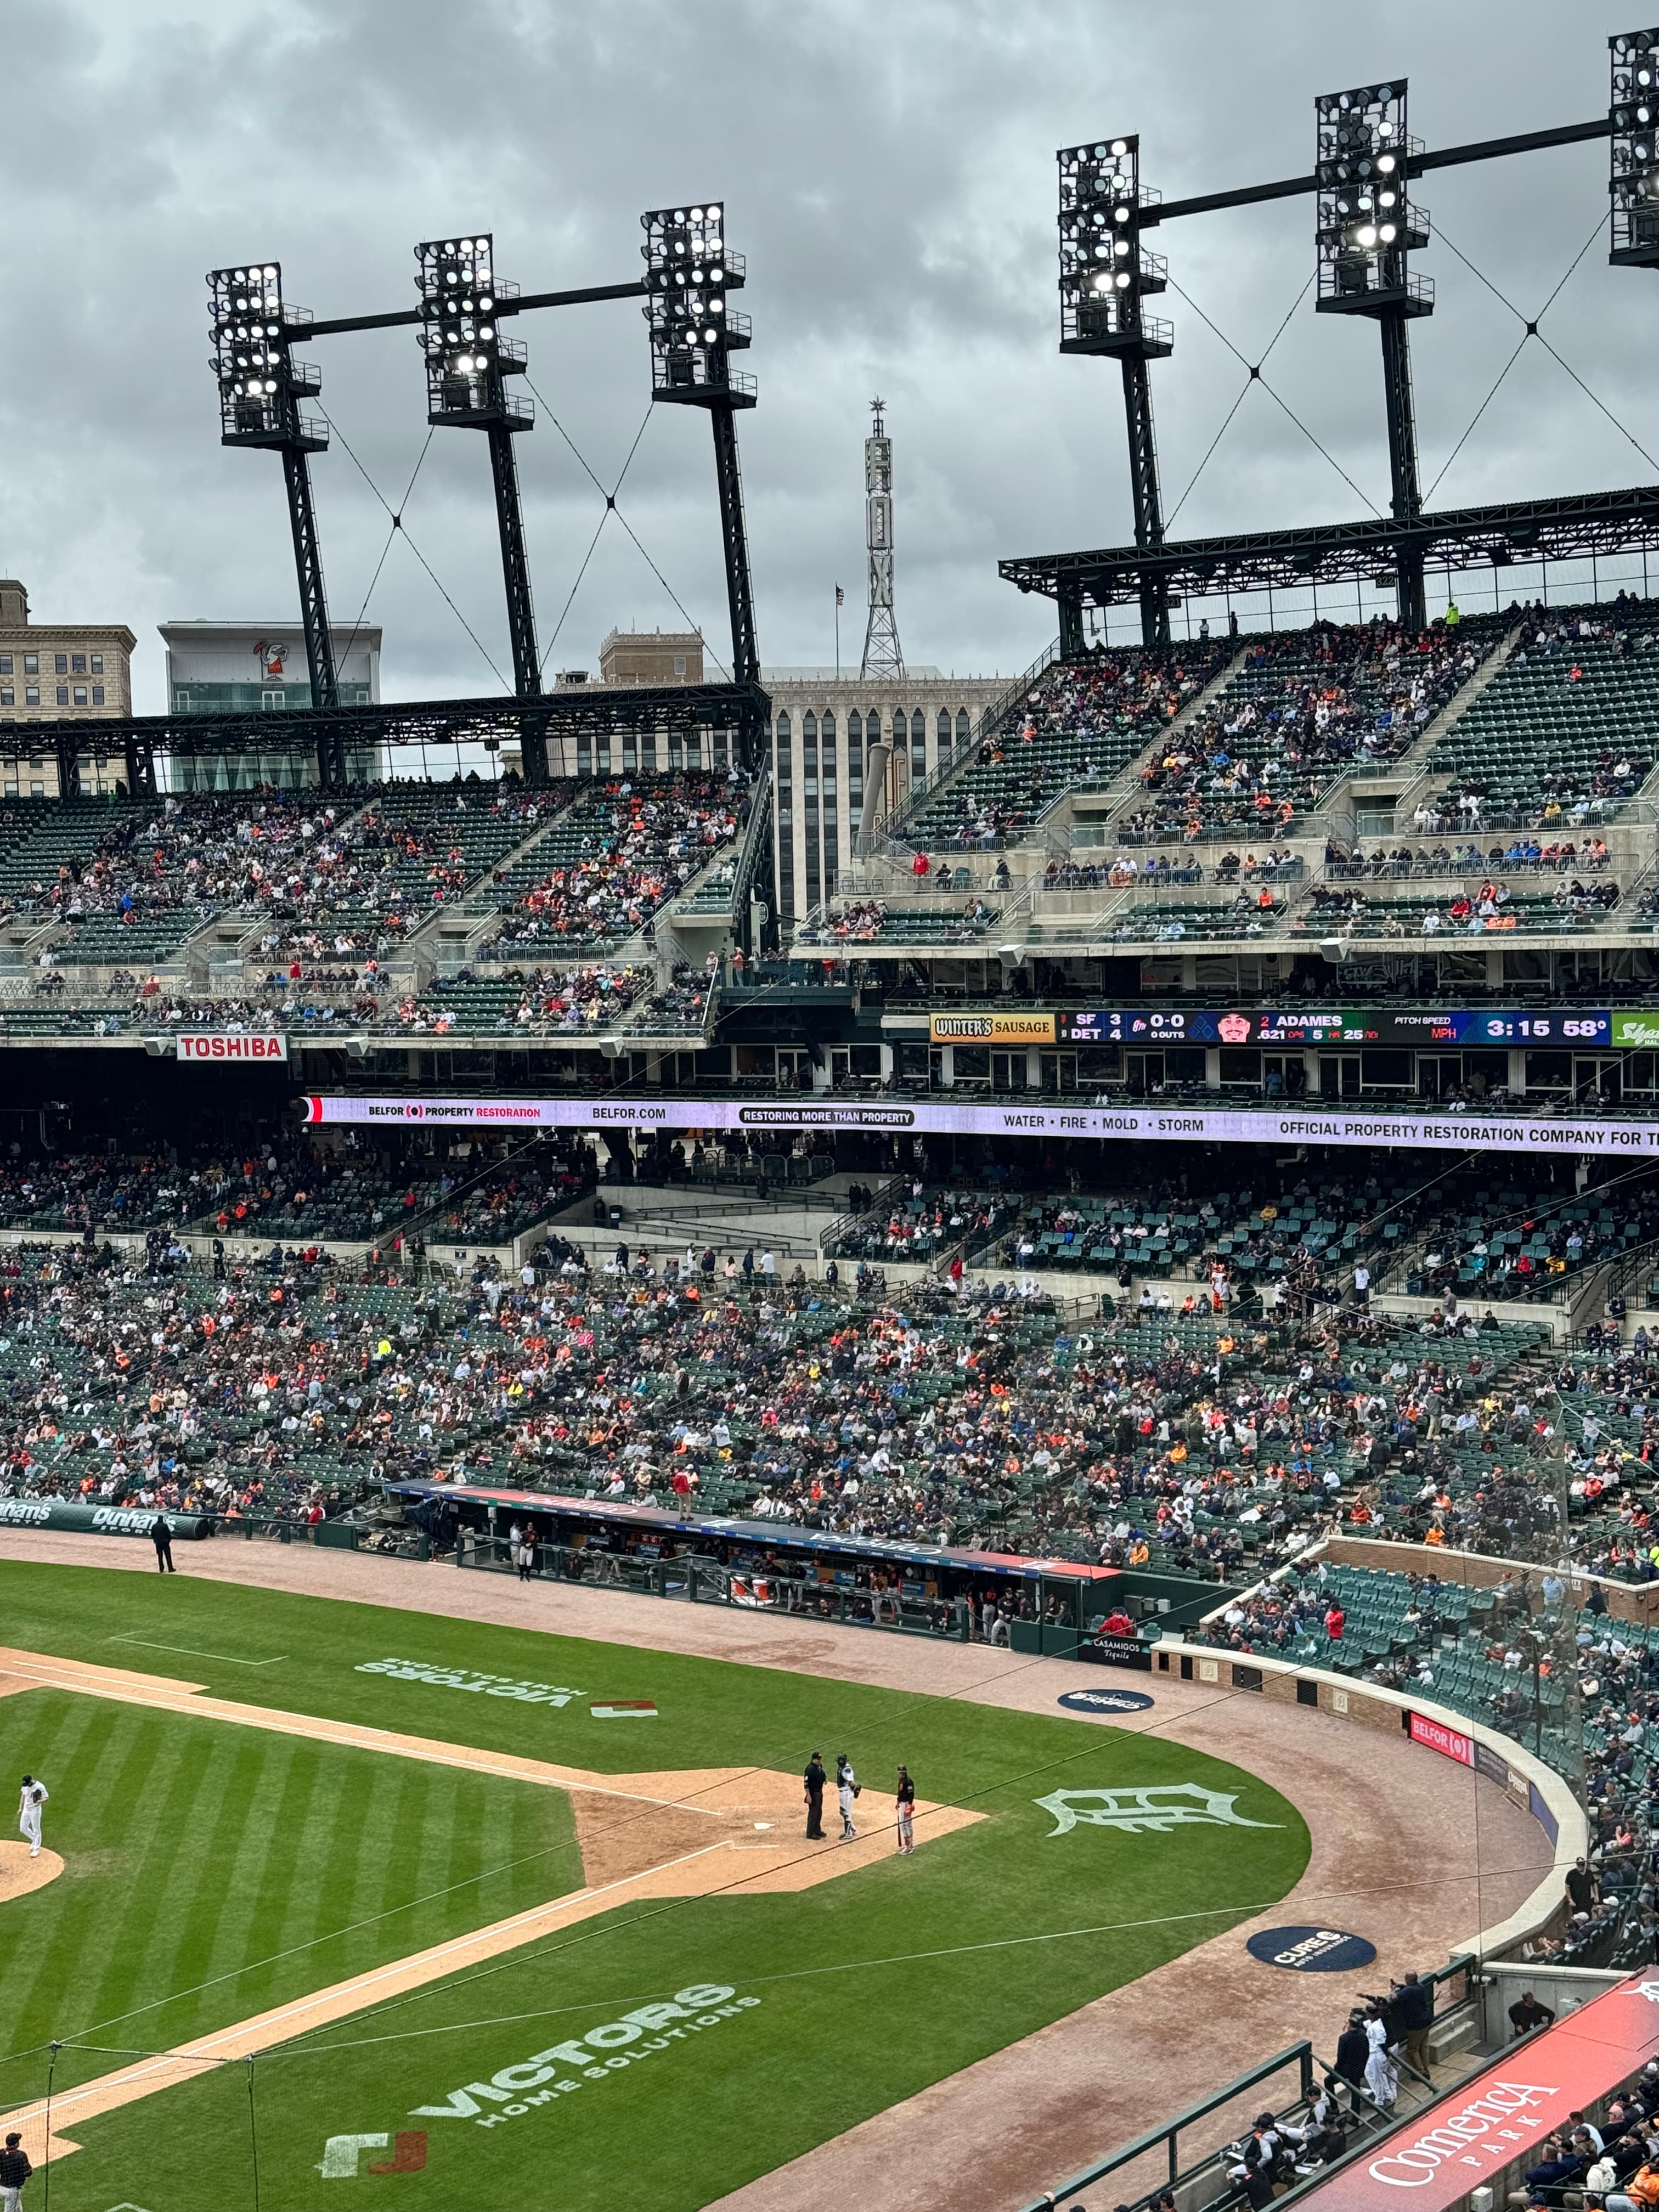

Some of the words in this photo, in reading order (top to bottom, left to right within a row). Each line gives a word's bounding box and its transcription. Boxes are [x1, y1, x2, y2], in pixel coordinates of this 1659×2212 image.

[1076, 1014, 1096, 1025] SF
[1109, 1014, 1121, 1025] 3
[1150, 1014, 1184, 1027] 0-0
[1260, 1017, 1269, 1027] 2
[1276, 1015, 1342, 1026] ADAMES
[935, 1018, 993, 1037] WINTER'S
[995, 1022, 1049, 1032] SAUSAGE
[1071, 1029, 1102, 1039] DET
[1109, 1029, 1122, 1040] 4
[1257, 1030, 1285, 1039] .621
[1312, 1030, 1323, 1039] 5
[1344, 1030, 1363, 1039] 25
[1430, 1028, 1456, 1039] MPH
[1487, 1020, 1550, 1036] 3:15
[181, 1037, 282, 1057] TOSHIBA
[369, 1106, 404, 1115] BELFOR
[425, 1107, 474, 1117] PROPERTY
[476, 1108, 540, 1118] RESTORATION
[592, 1108, 665, 1119] BELFOR.COM
[743, 1110, 799, 1121] RESTORING
[802, 1111, 831, 1122] MORE
[833, 1111, 860, 1122] THAN
[862, 1112, 911, 1123] PROPERTY
[1004, 1115, 1045, 1127] WATER
[1060, 1116, 1087, 1128] FIRE
[1103, 1118, 1138, 1130] MOLD
[1158, 1119, 1203, 1131] STORM
[1280, 1121, 1340, 1135] OFFICIAL
[1345, 1123, 1418, 1137] PROPERTY
[1424, 1126, 1523, 1141] RESTORATION
[1529, 1129, 1605, 1144] COMPANY
[1611, 1132, 1641, 1145] FOR
[1647, 1132, 1659, 1146] T
[1094, 1639, 1140, 1652] CASAMIGOS
[1104, 1649, 1130, 1660] Tequila
[382, 1657, 514, 1683] SOLUTIONS
[354, 1662, 573, 1708] VICTORS
[516, 1681, 589, 1696] HOME
[1413, 1720, 1448, 1748] BELFOR
[1273, 1938, 1328, 1963] CURE
[1294, 1956, 1314, 1967] AUTO
[407, 1983, 736, 2118] VICTORS
[476, 2079, 582, 2128] HOME
[583, 1996, 763, 2079] SOLUTIONS
[1459, 2115, 1543, 2167] PARK
